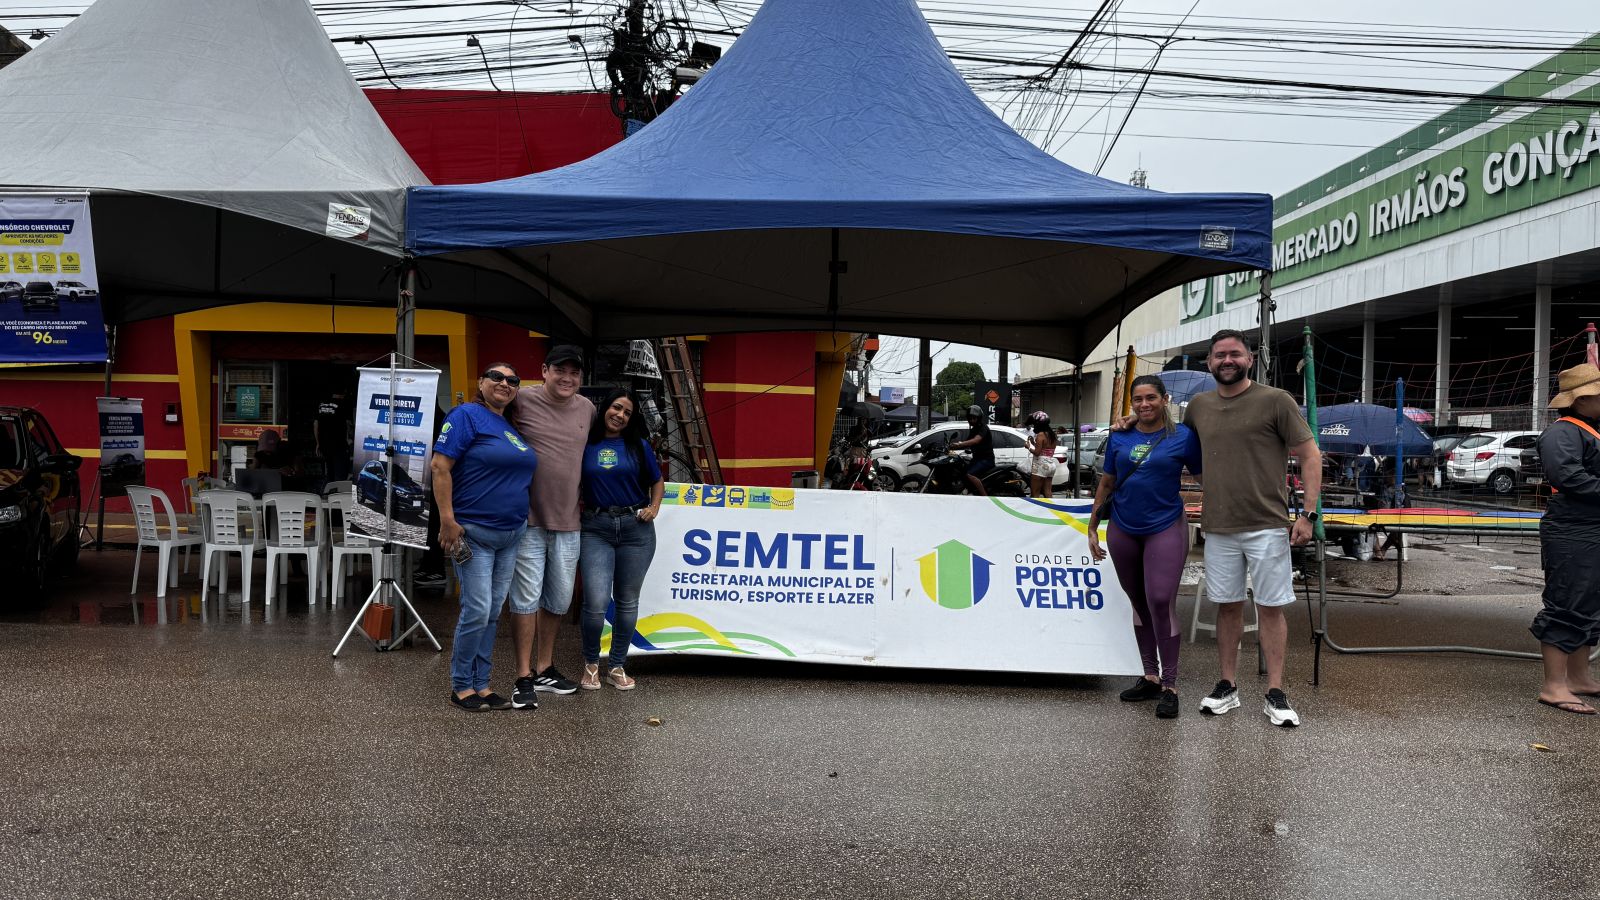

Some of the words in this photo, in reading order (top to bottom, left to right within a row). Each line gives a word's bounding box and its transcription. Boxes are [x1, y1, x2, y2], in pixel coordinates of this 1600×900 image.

[1368, 170, 1467, 238] IRMÃOS
[32, 332, 53, 344] 96
[375, 398, 391, 407] VEND
[682, 528, 875, 570] SEMTEL
[1015, 554, 1072, 565] CIDADE
[671, 572, 764, 587] SECRETARIA
[767, 575, 852, 589] MUNICIPAL
[855, 577, 874, 589] DE
[1015, 566, 1102, 588] PORTO
[670, 588, 743, 604] TURISMO,
[747, 591, 813, 604] ESPORTE
[817, 592, 825, 604] E
[828, 592, 874, 605] LAZER
[1016, 588, 1104, 611] VELHO
